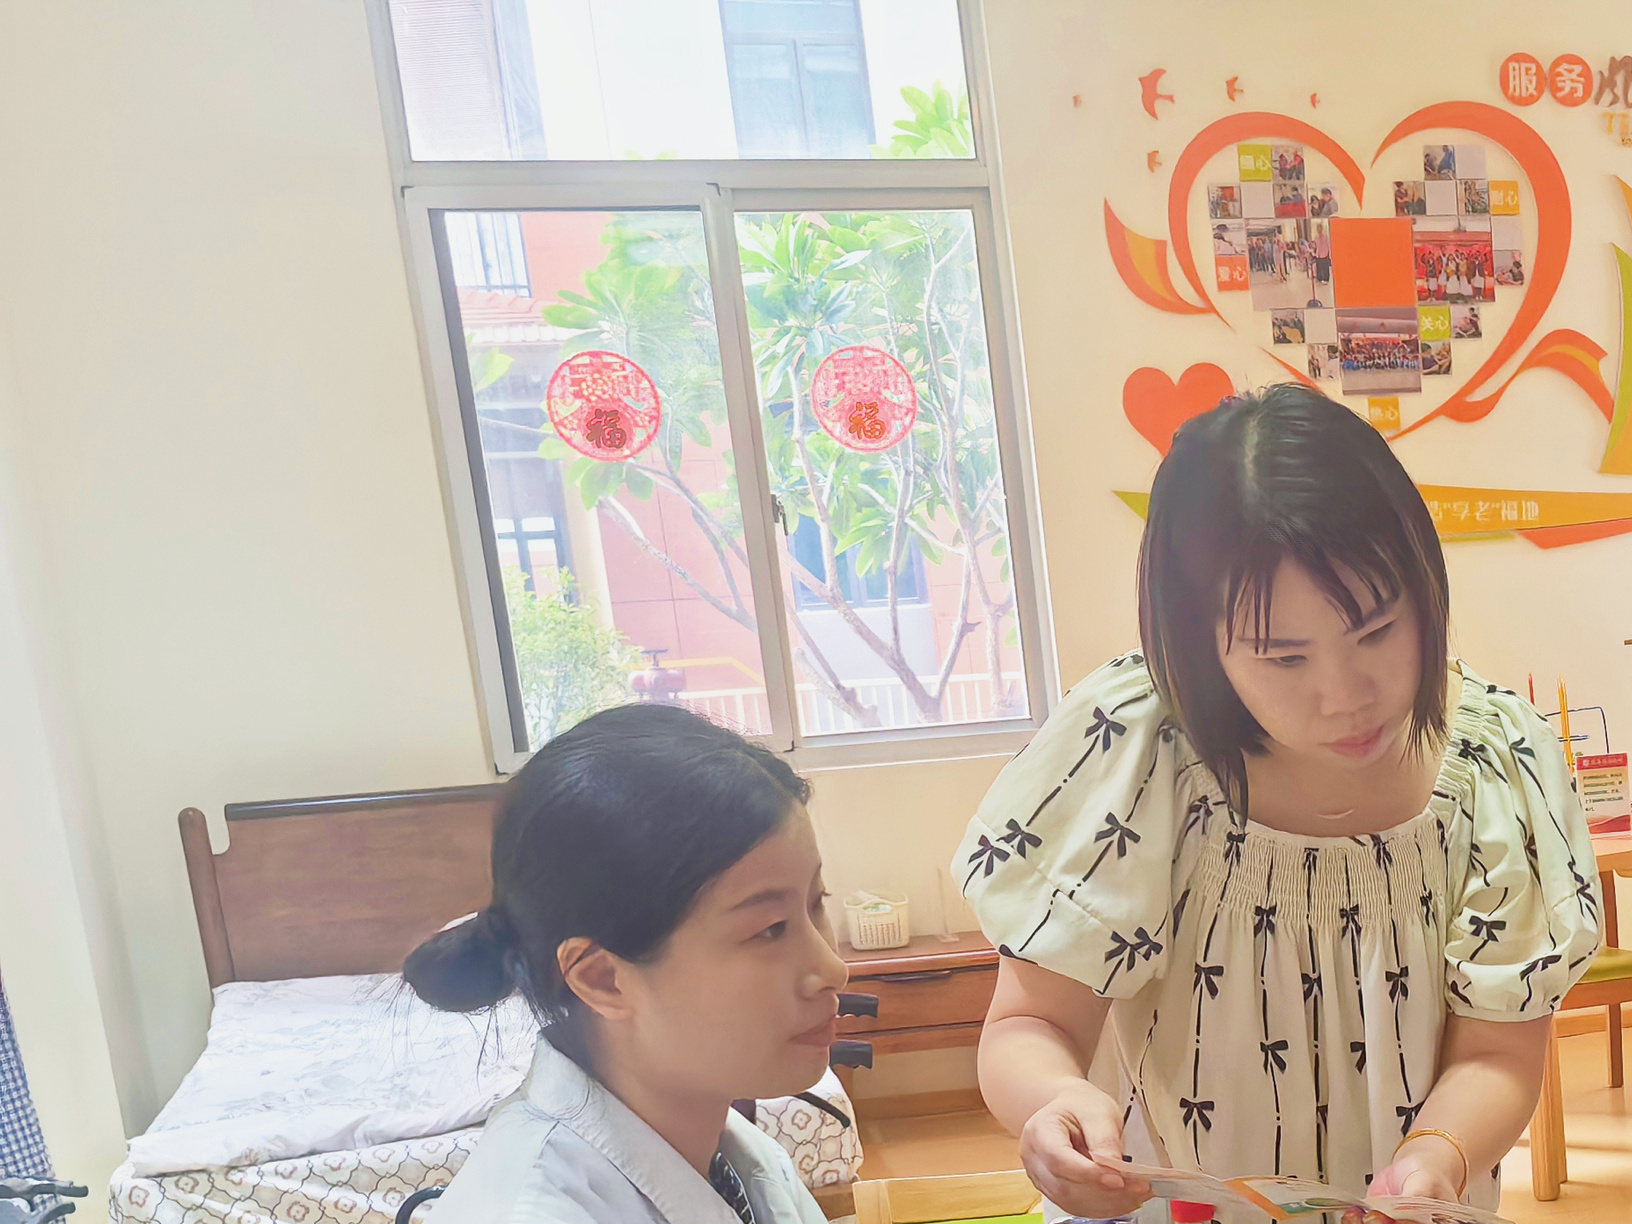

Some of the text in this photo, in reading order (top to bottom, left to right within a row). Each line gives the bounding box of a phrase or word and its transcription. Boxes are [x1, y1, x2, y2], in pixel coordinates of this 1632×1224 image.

[1240, 155, 1273, 170] 心
[1491, 190, 1519, 206] 心
[848, 401, 886, 441] 福
[1370, 404, 1398, 421] 心
[586, 408, 626, 449] 福
